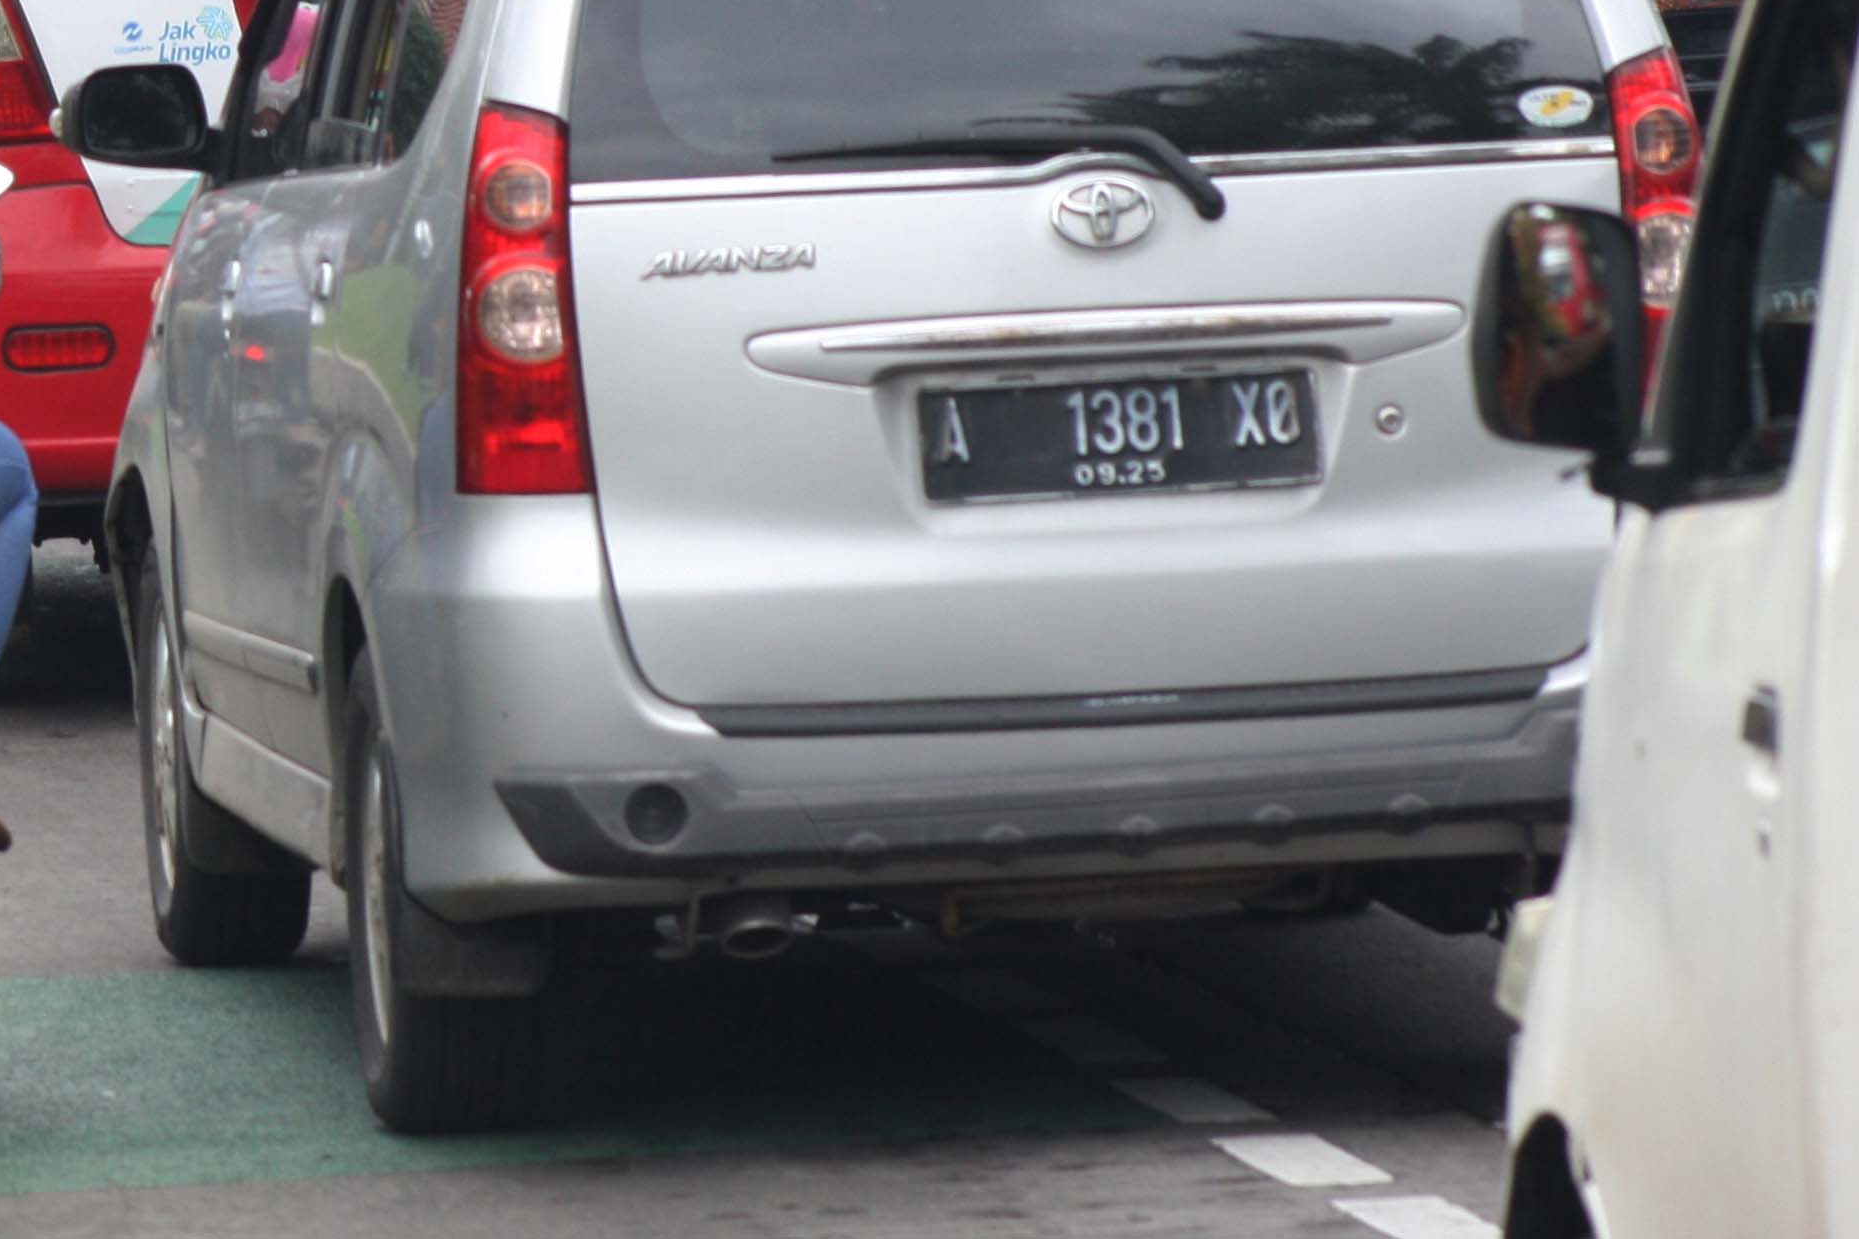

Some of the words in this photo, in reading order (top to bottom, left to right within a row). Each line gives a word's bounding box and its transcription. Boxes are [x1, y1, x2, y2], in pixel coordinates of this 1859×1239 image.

[158, 21, 197, 41] Jak
[158, 41, 232, 66] Lingko
[640, 241, 817, 282] AVANZA
[936, 396, 971, 463] A
[1066, 383, 1185, 457] 1381
